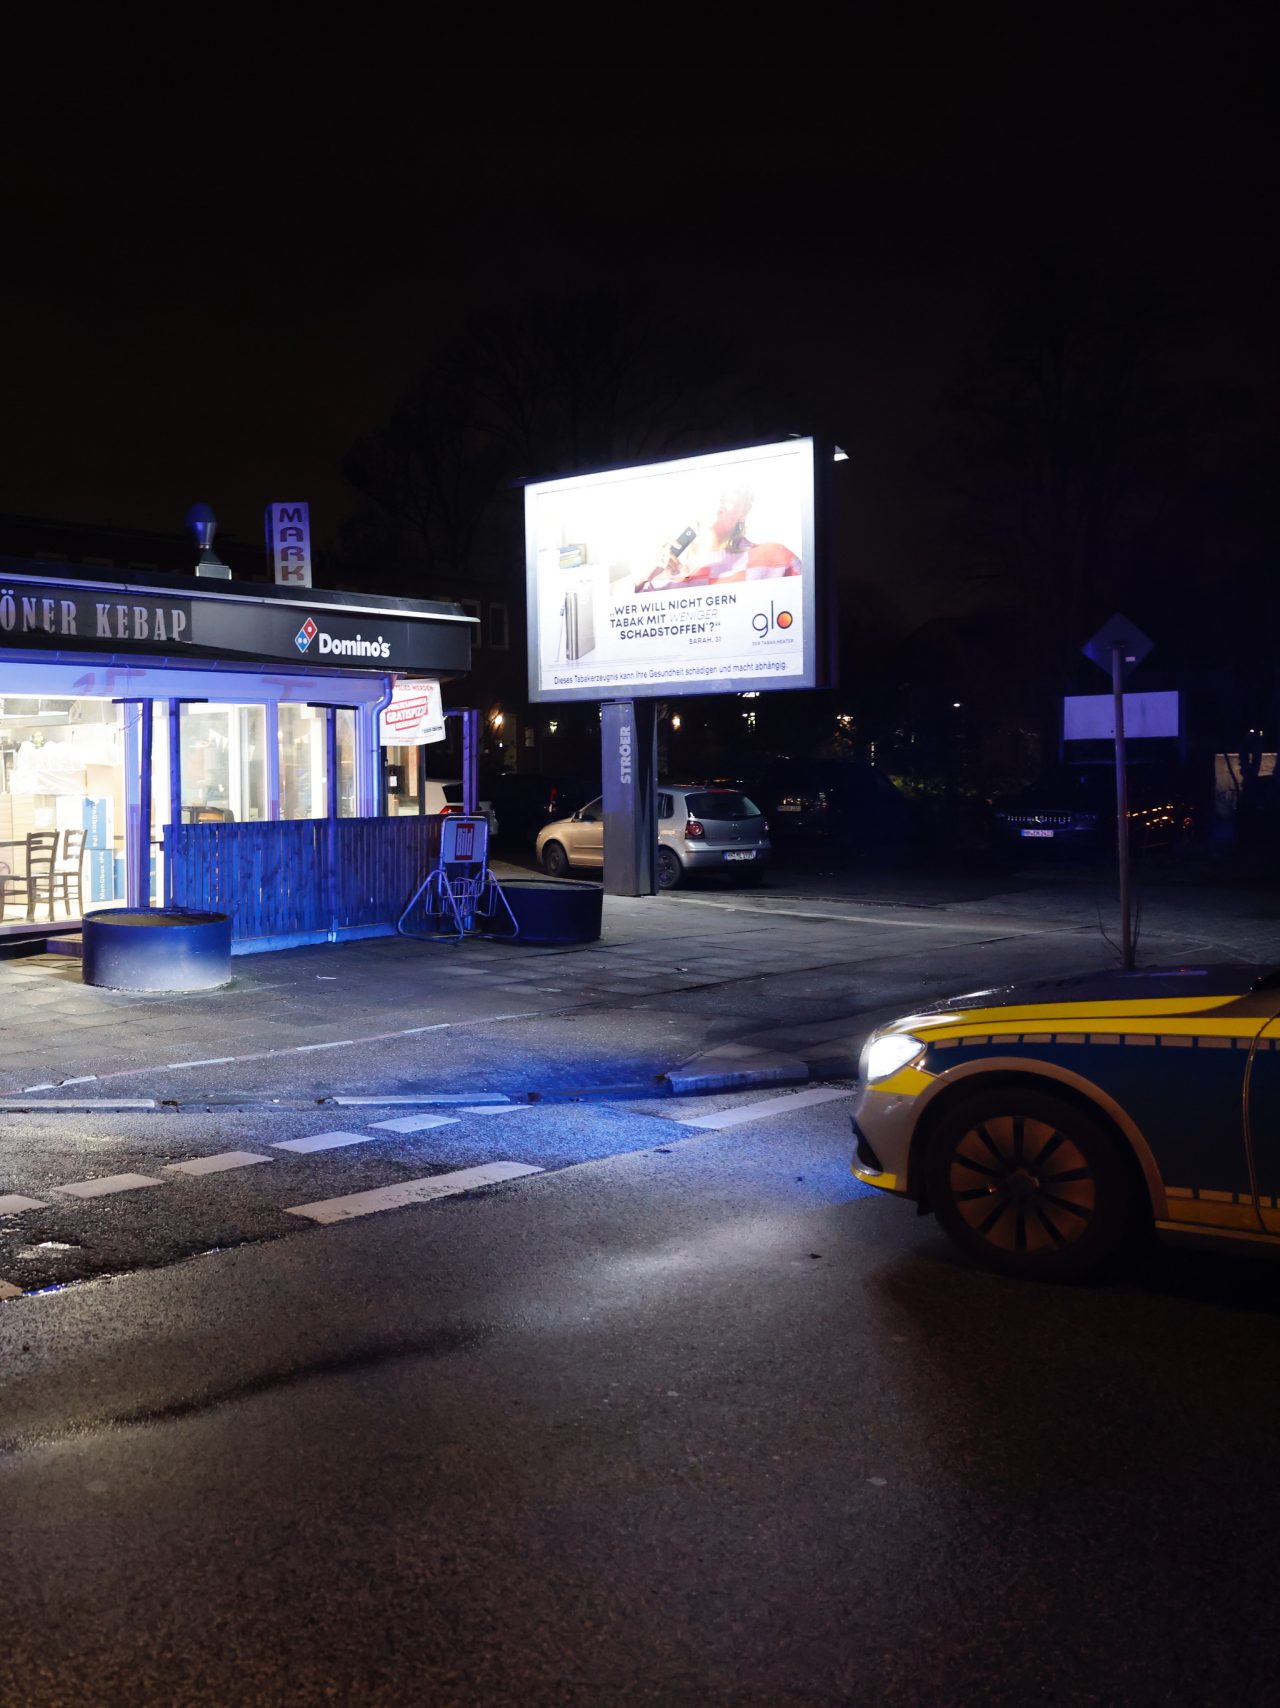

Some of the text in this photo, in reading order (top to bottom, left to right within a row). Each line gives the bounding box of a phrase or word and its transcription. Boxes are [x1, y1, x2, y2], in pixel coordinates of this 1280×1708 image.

[640, 602, 665, 613] WILL
[669, 598, 702, 610] NICHT
[706, 594, 736, 606] GERN
[95, 603, 187, 641] KEBAP
[610, 608, 718, 628] TABAK MIT WENIGER
[752, 600, 793, 638] glo
[319, 632, 391, 658] Domino's
[554, 676, 573, 684] Dieses
[575, 672, 618, 682] Tabakerzeugnis
[649, 667, 684, 678] Gesundheit
[720, 663, 731, 673] und
[733, 662, 754, 672] macht
[619, 726, 631, 784] STRÖER
